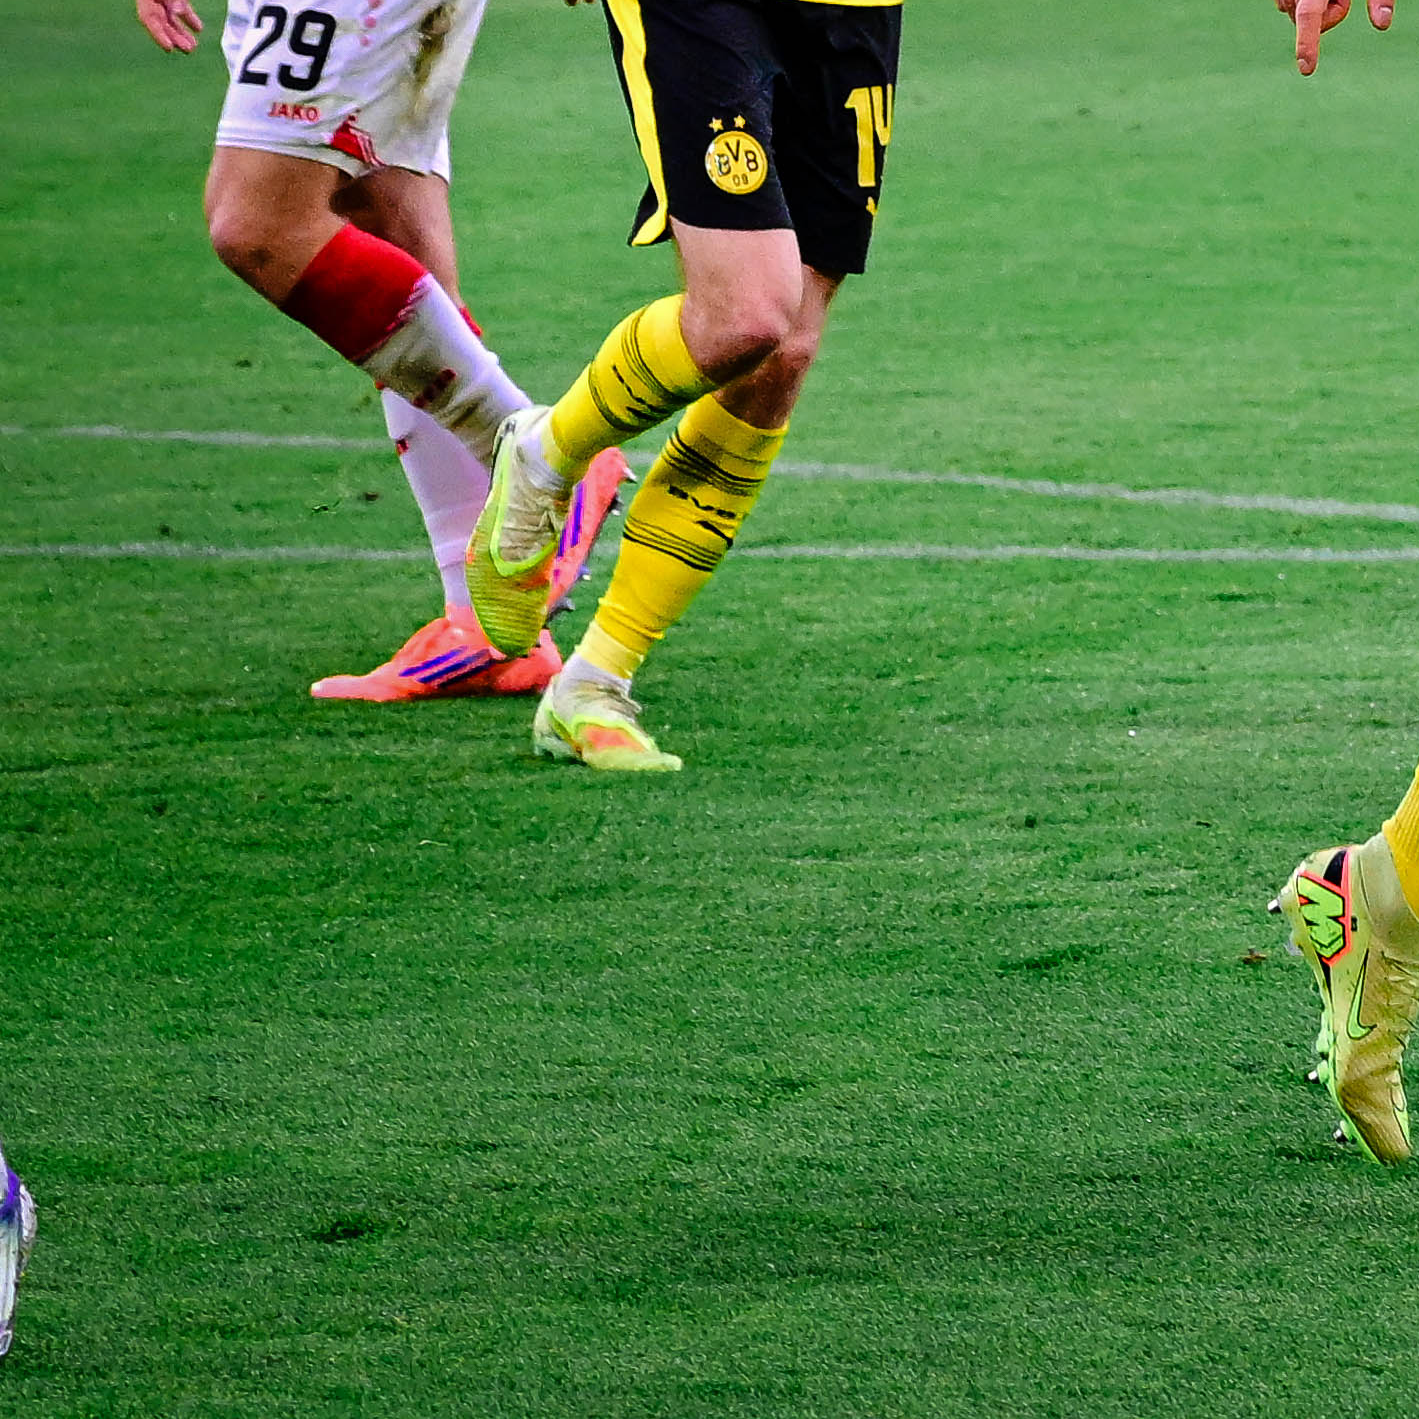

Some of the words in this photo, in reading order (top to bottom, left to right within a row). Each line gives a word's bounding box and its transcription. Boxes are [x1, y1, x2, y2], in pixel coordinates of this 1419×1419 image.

[237, 5, 337, 92] 29
[268, 101, 320, 122] JAKO
[717, 140, 759, 178] BVB
